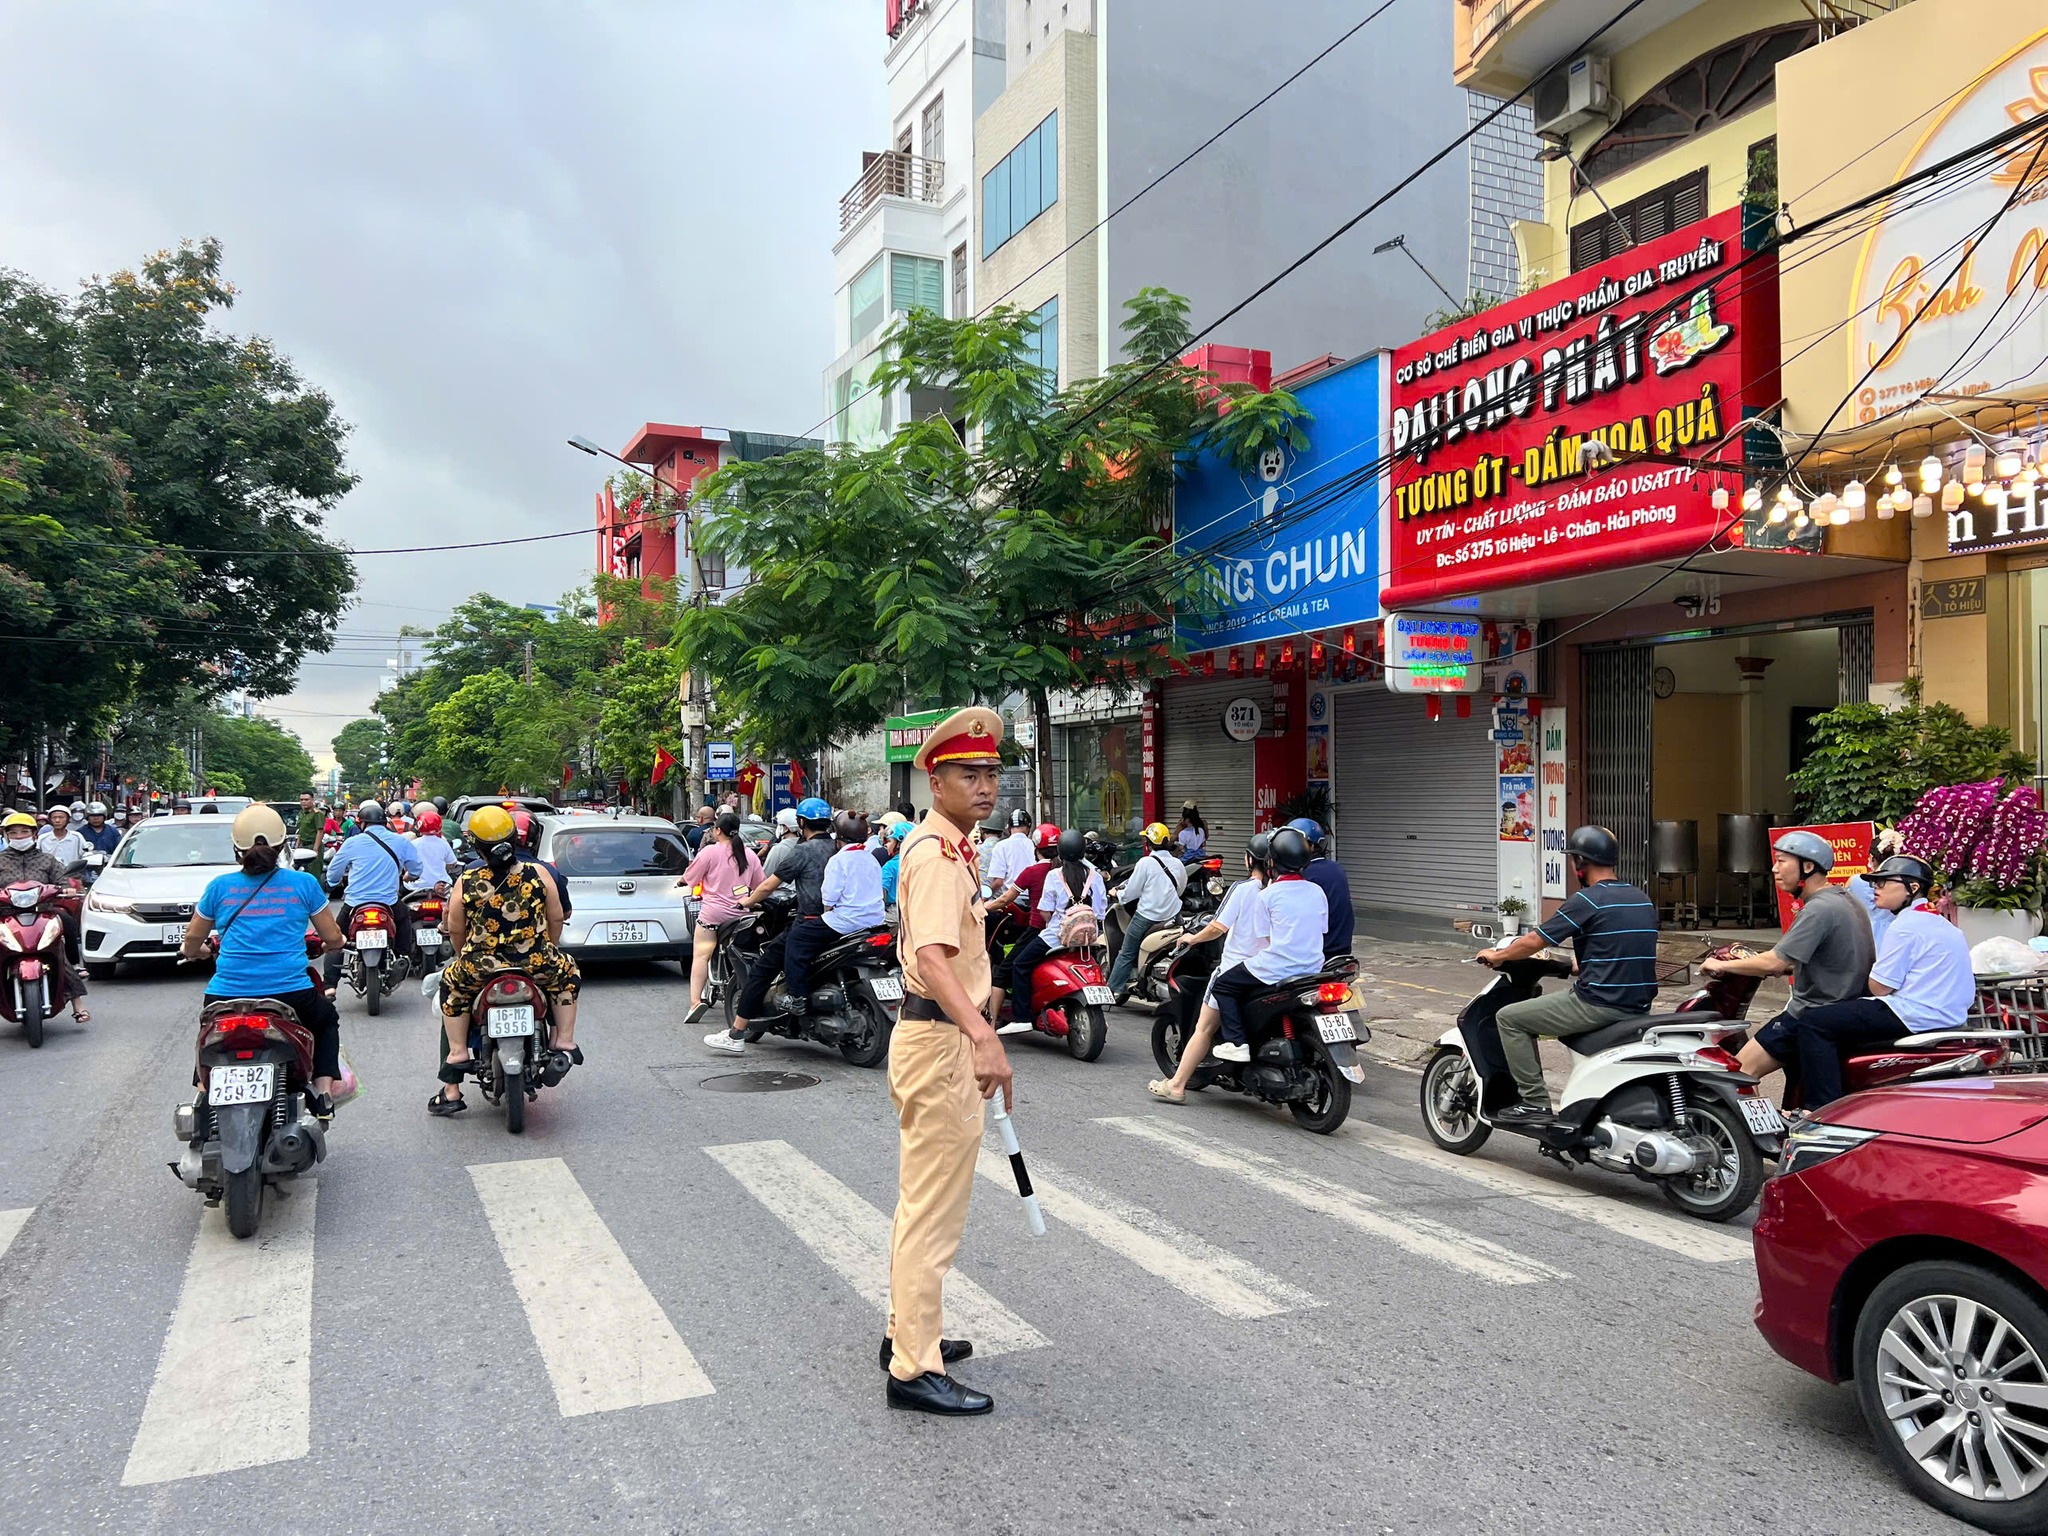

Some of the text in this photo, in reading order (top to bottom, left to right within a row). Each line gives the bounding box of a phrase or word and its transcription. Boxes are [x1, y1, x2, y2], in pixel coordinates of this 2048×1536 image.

[1396, 237, 1719, 385] CƠ SỞ CHẾ BIẾN GIA VỊ THỰC PHẨM GIA TRUYỀN
[1393, 313, 1642, 464] ĐẠI LONG PHÁT
[1879, 387, 1898, 399] 377
[1396, 468, 1467, 520] TƯƠNG
[1474, 455, 1503, 499] ỚT
[1525, 427, 1584, 485] DẤM
[1655, 383, 1718, 454] QUẢ
[1416, 527, 1435, 546] UY
[1435, 519, 1456, 540] TÍN
[1463, 506, 1499, 535] CHẤT
[1500, 500, 1547, 525] LƯỢNG
[1558, 486, 1593, 513] ĐẢM
[1595, 477, 1628, 504] BẢO
[1455, 543, 1469, 564] Số
[1471, 538, 1493, 560] 375
[1495, 535, 1509, 555] Tô
[1544, 526, 1558, 546] Lê
[1566, 518, 1601, 540] Chân
[1632, 504, 1677, 527] Phòng
[1200, 560, 1254, 612] ING
[1265, 526, 1366, 595] CHUN
[1949, 581, 1978, 599] 377
[1944, 597, 1982, 612] TÔ HIỆU
[1226, 616, 1247, 630] 2012
[1252, 613, 1268, 626] ICE
[1268, 604, 1301, 622] CREAM
[1302, 602, 1309, 616] &
[1311, 597, 1330, 614] TEA
[1419, 620, 1449, 635] LONG
[1427, 651, 1450, 663] HOA
[1230, 706, 1256, 722] 371
[1542, 761, 1565, 786] TƯƠNG
[1502, 781, 1527, 791] Trà mát
[1257, 784, 1277, 809] SÀN
[1542, 829, 1566, 852] TƯƠNG
[619, 923, 636, 932] 34A
[612, 933, 643, 941] 537.63
[496, 1008, 527, 1021] 16-M2
[1321, 1015, 1347, 1029] 15-B2
[495, 1021, 527, 1034] 5956
[1745, 1099, 1771, 1115] 15-B1
